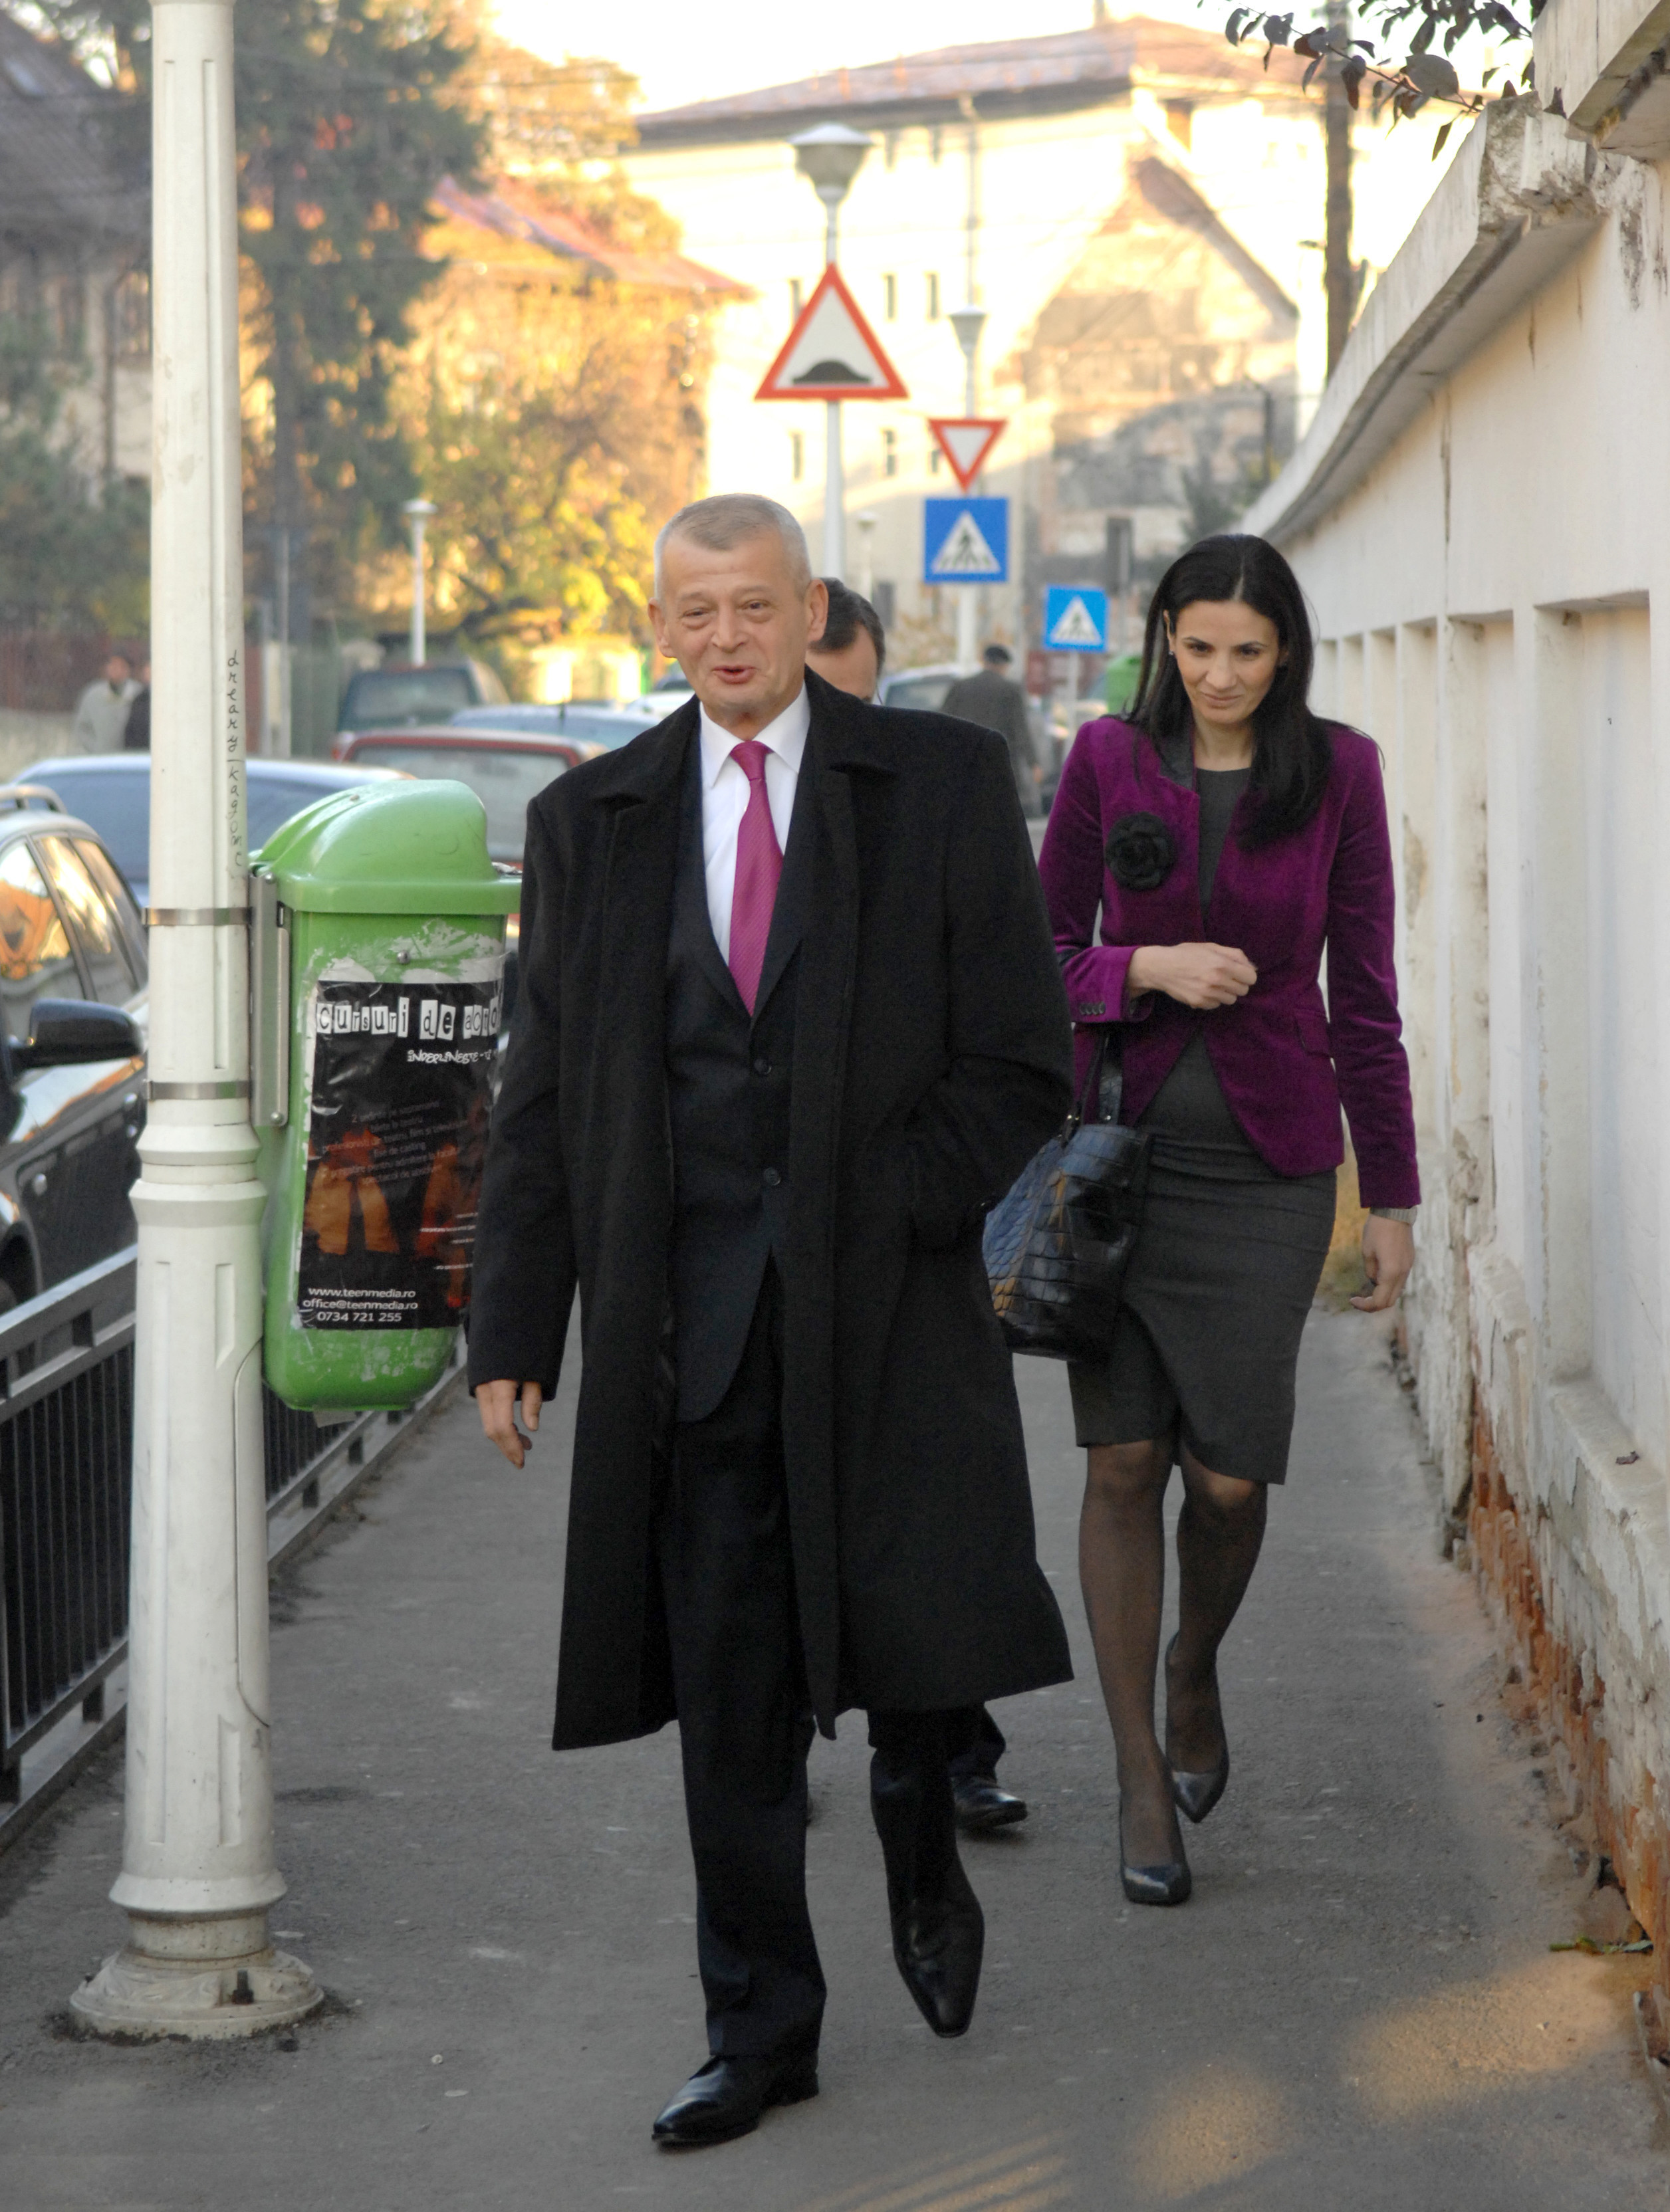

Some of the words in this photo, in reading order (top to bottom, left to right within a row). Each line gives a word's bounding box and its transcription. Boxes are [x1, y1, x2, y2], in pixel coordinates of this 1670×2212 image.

[422, 1008, 453, 1037] de
[308, 1287, 416, 1298] www.teenmedia.ro
[302, 1298, 419, 1310] office@teenmedia.ro
[317, 1311, 349, 1322] 0734
[353, 1313, 374, 1322] 721
[378, 1313, 402, 1322] 255
